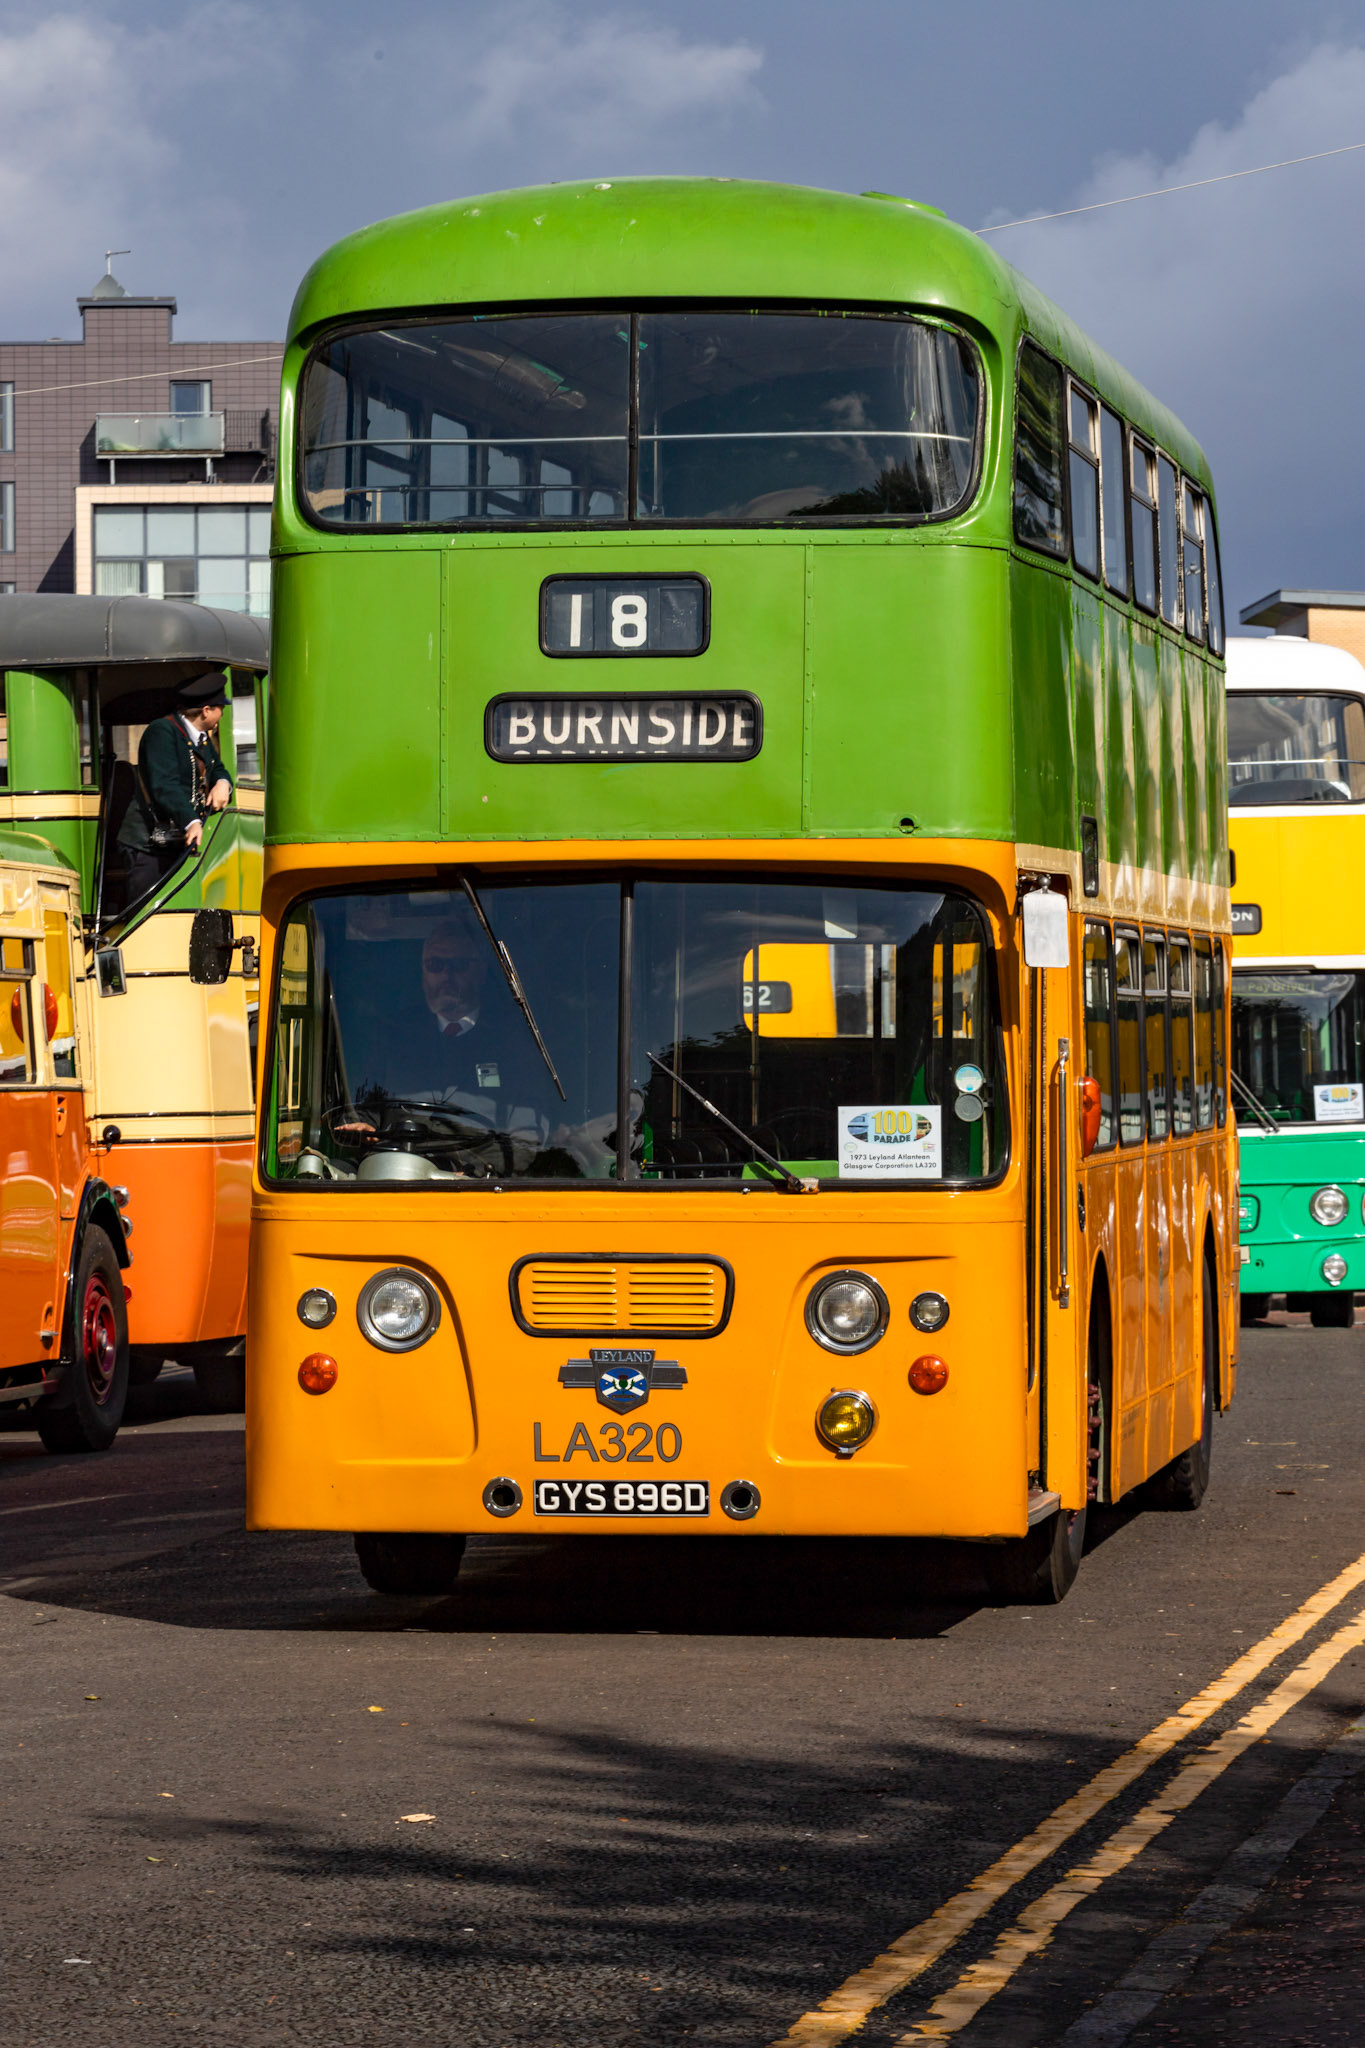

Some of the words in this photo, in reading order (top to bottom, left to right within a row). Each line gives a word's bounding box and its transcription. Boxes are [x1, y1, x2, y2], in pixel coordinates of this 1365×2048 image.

[508, 700, 755, 747] BURNSIDE
[743, 985, 771, 1007] 62
[1247, 983, 1270, 993] Pay
[872, 1110, 912, 1135] 100
[874, 1135, 911, 1144] PARADE
[593, 1350, 653, 1363] LEYLAND
[533, 1422, 683, 1462] LA320
[538, 1482, 608, 1512] GYS
[613, 1482, 707, 1513] 896D
